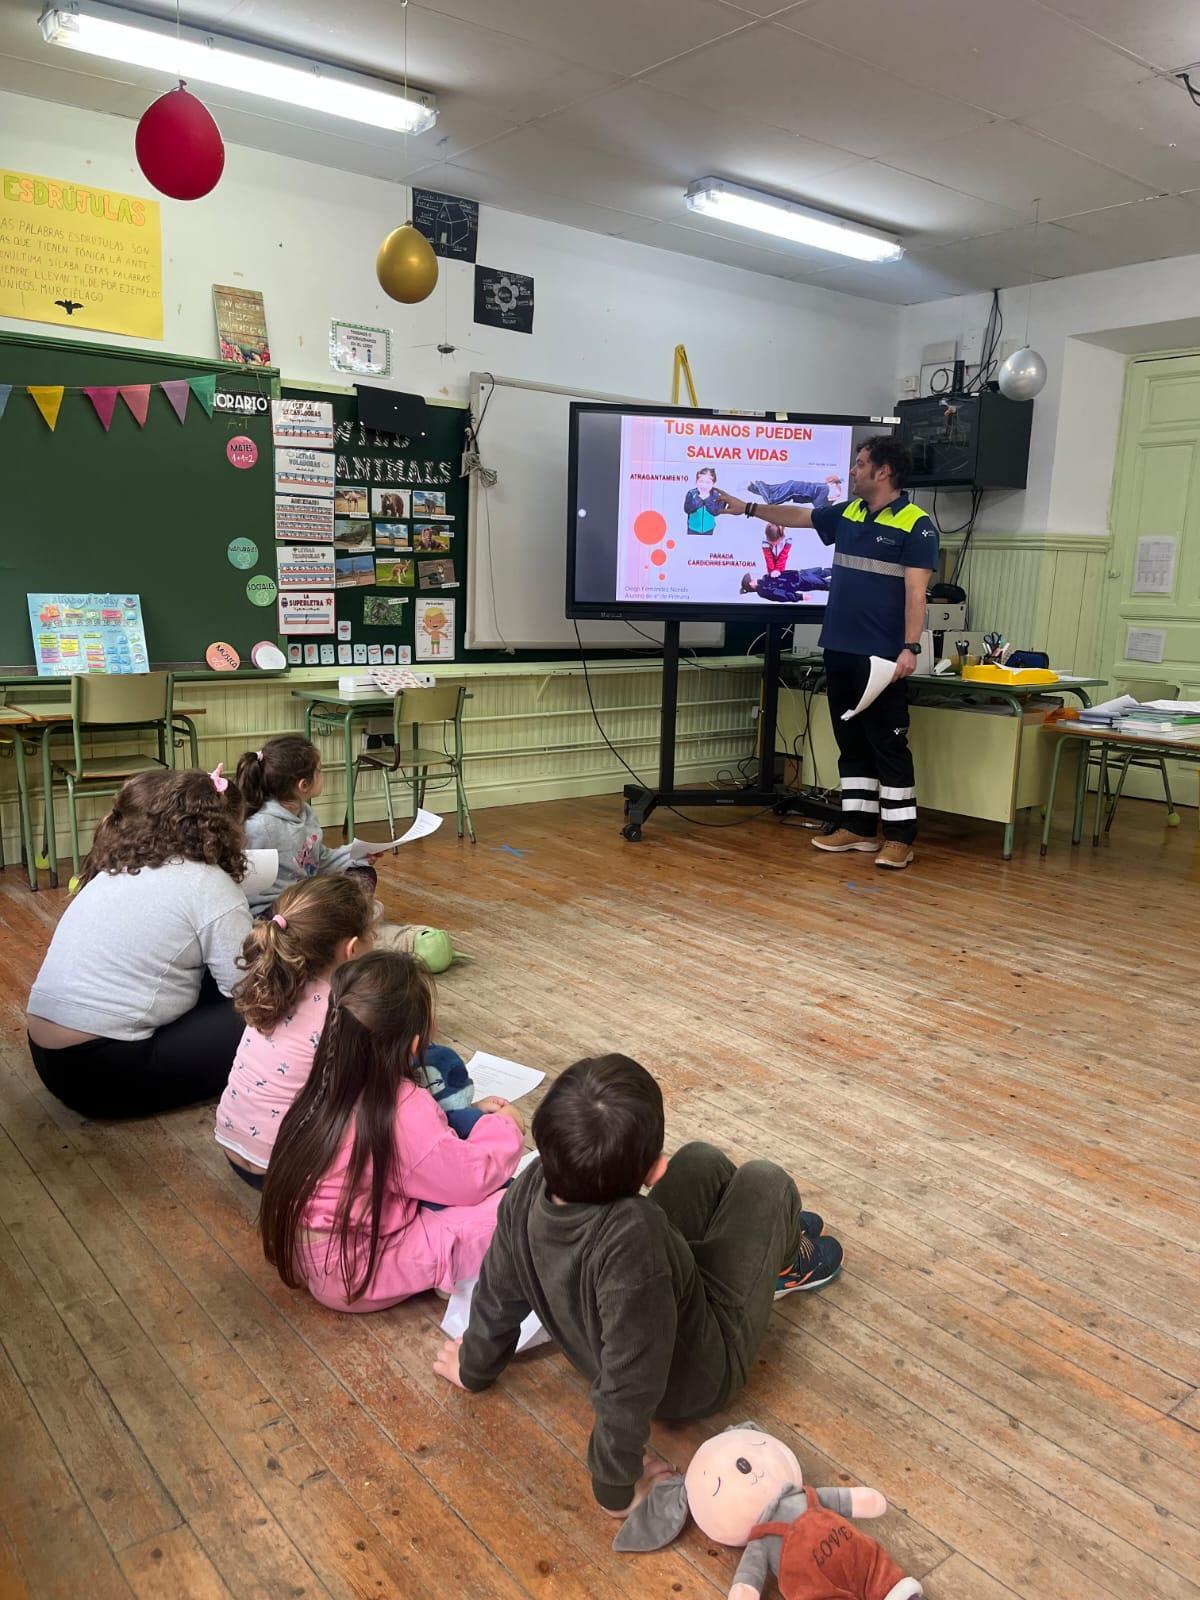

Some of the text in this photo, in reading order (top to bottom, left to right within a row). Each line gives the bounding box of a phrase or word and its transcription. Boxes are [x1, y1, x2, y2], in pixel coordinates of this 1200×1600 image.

[0, 217, 14, 231] AS
[19, 219, 64, 241] PALABRAS
[131, 243, 150, 256] SON
[0, 234, 10, 243] AS
[14, 236, 33, 248] QUE
[0, 263, 29, 278] IEMPRE
[664, 419, 812, 442] TUS MANOS PUEDEN
[230, 444, 253, 452] MATES
[687, 445, 789, 463] SALVAR VIDAS
[335, 456, 452, 484] ANIMALS
[630, 473, 689, 482] ATRAGANTAMIENTO
[247, 583, 275, 591] SOCIALES
[812, 1525, 853, 1567] LOVE
